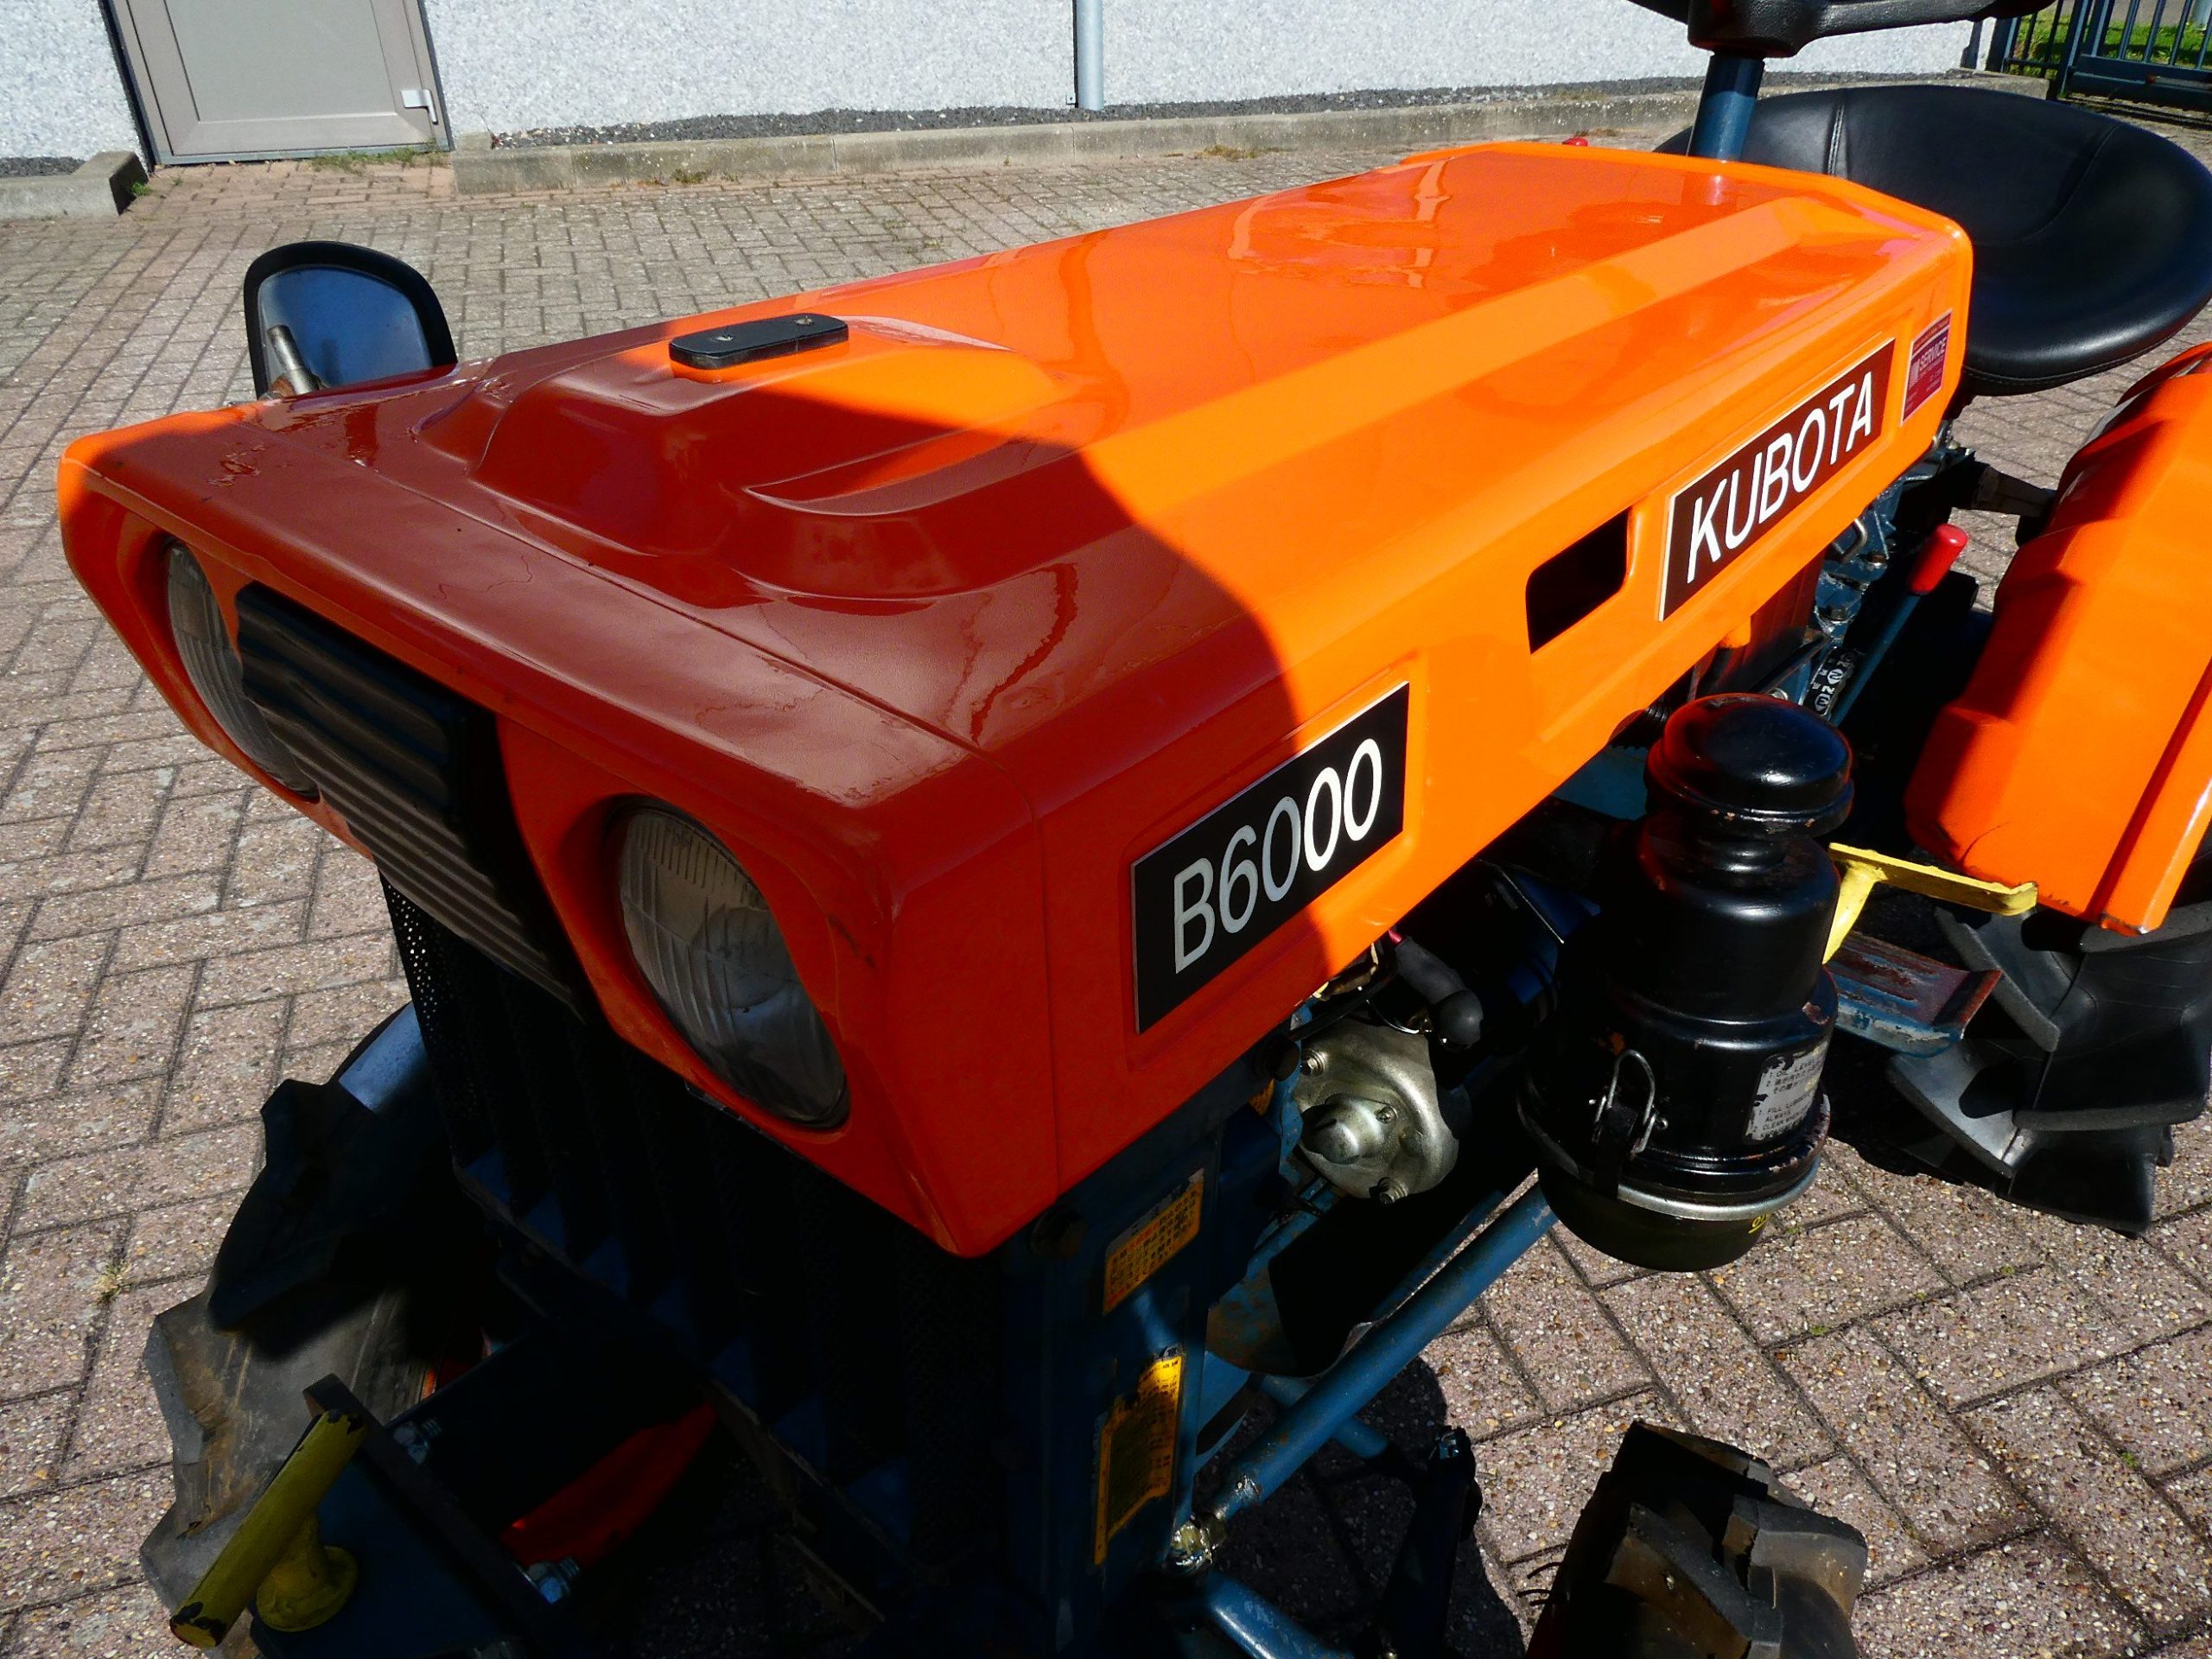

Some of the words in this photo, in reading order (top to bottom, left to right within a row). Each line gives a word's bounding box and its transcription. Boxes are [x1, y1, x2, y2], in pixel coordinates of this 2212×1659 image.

[1919, 336, 1947, 372] SERVICE
[1686, 371, 1873, 585] KUBOTA
[1173, 737, 1382, 975] B6000
